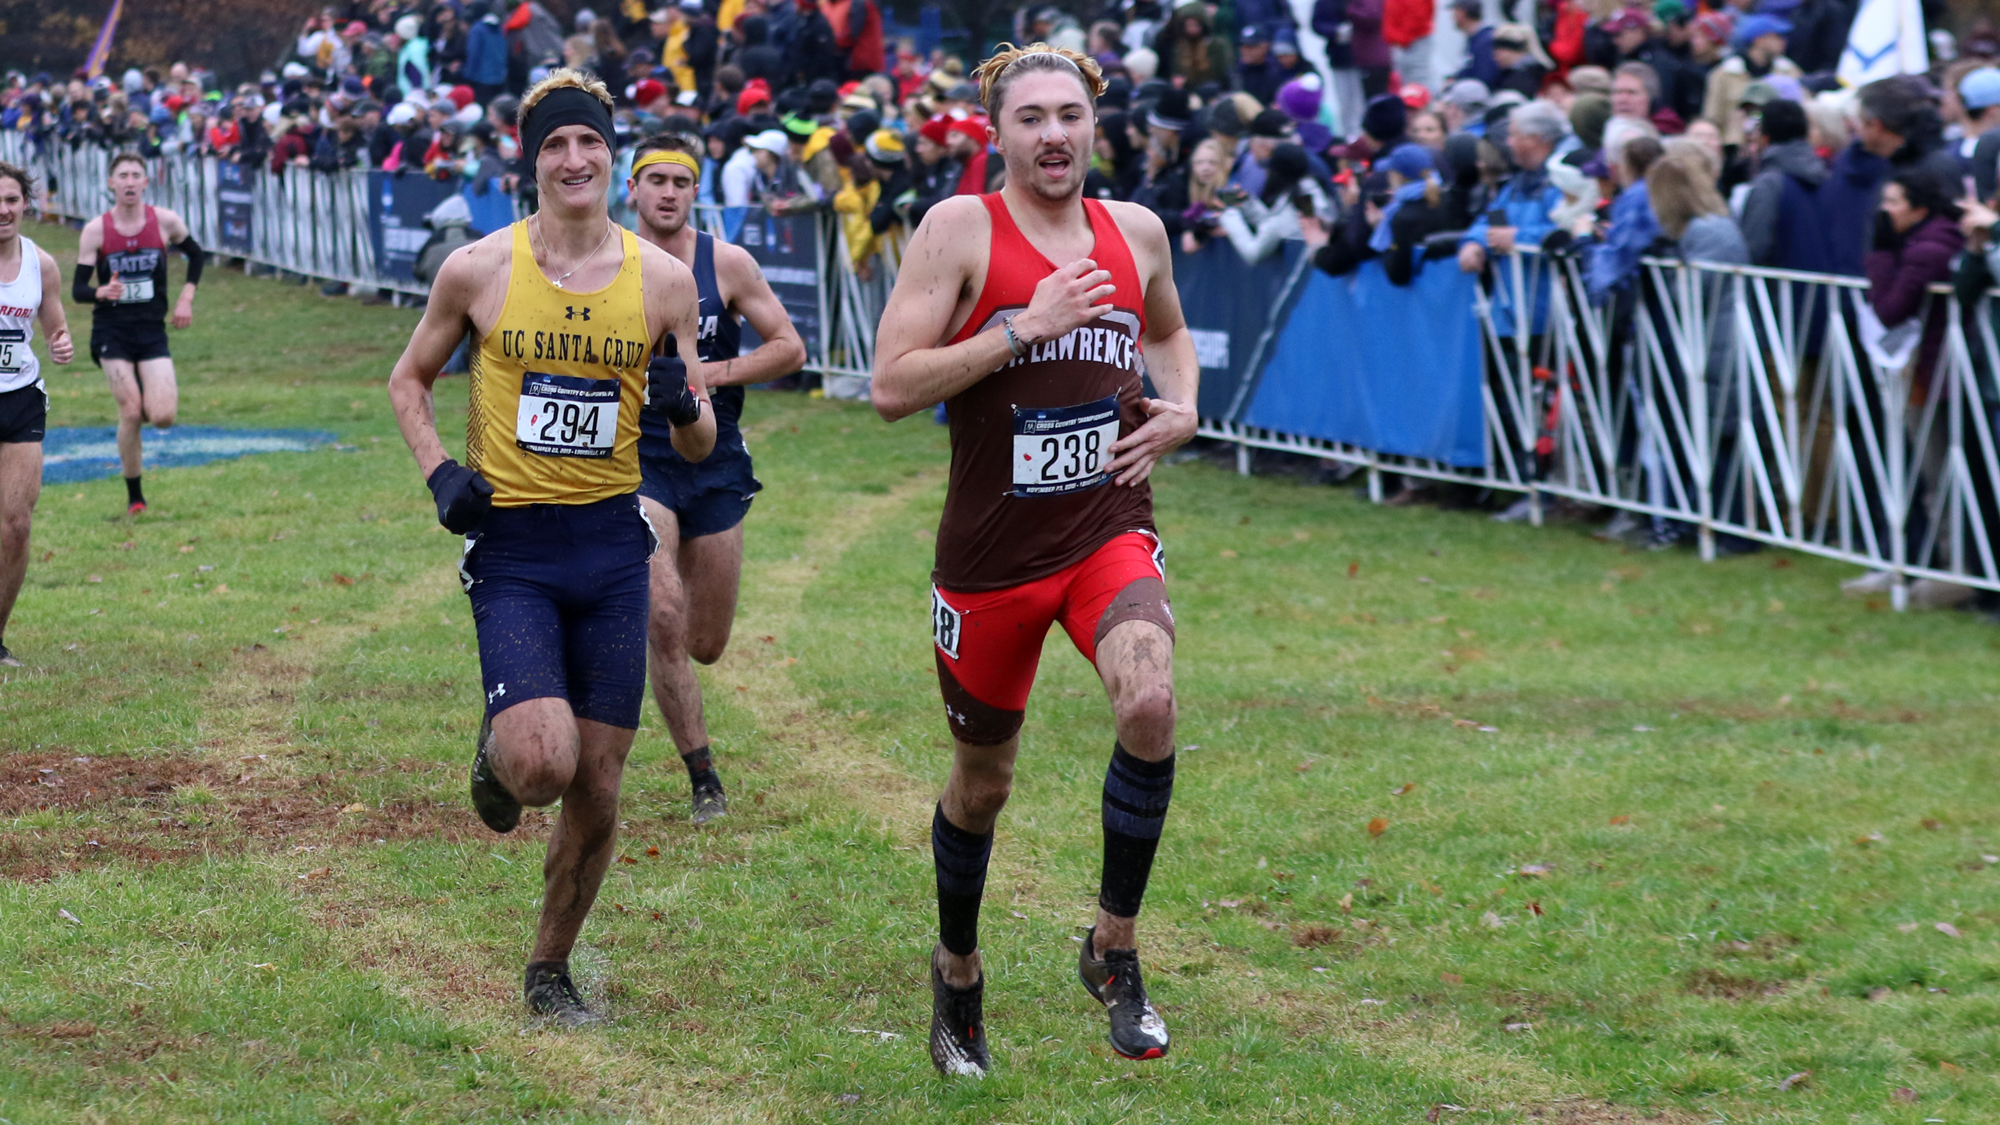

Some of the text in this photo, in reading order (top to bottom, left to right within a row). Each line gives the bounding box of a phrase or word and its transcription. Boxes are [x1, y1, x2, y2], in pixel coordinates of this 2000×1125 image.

[109, 254, 158, 272] BATES
[0, 344, 13, 366] 5
[503, 330, 644, 368] UC SANTA CRUZ
[540, 401, 599, 445] 294
[1041, 430, 1100, 481] 238
